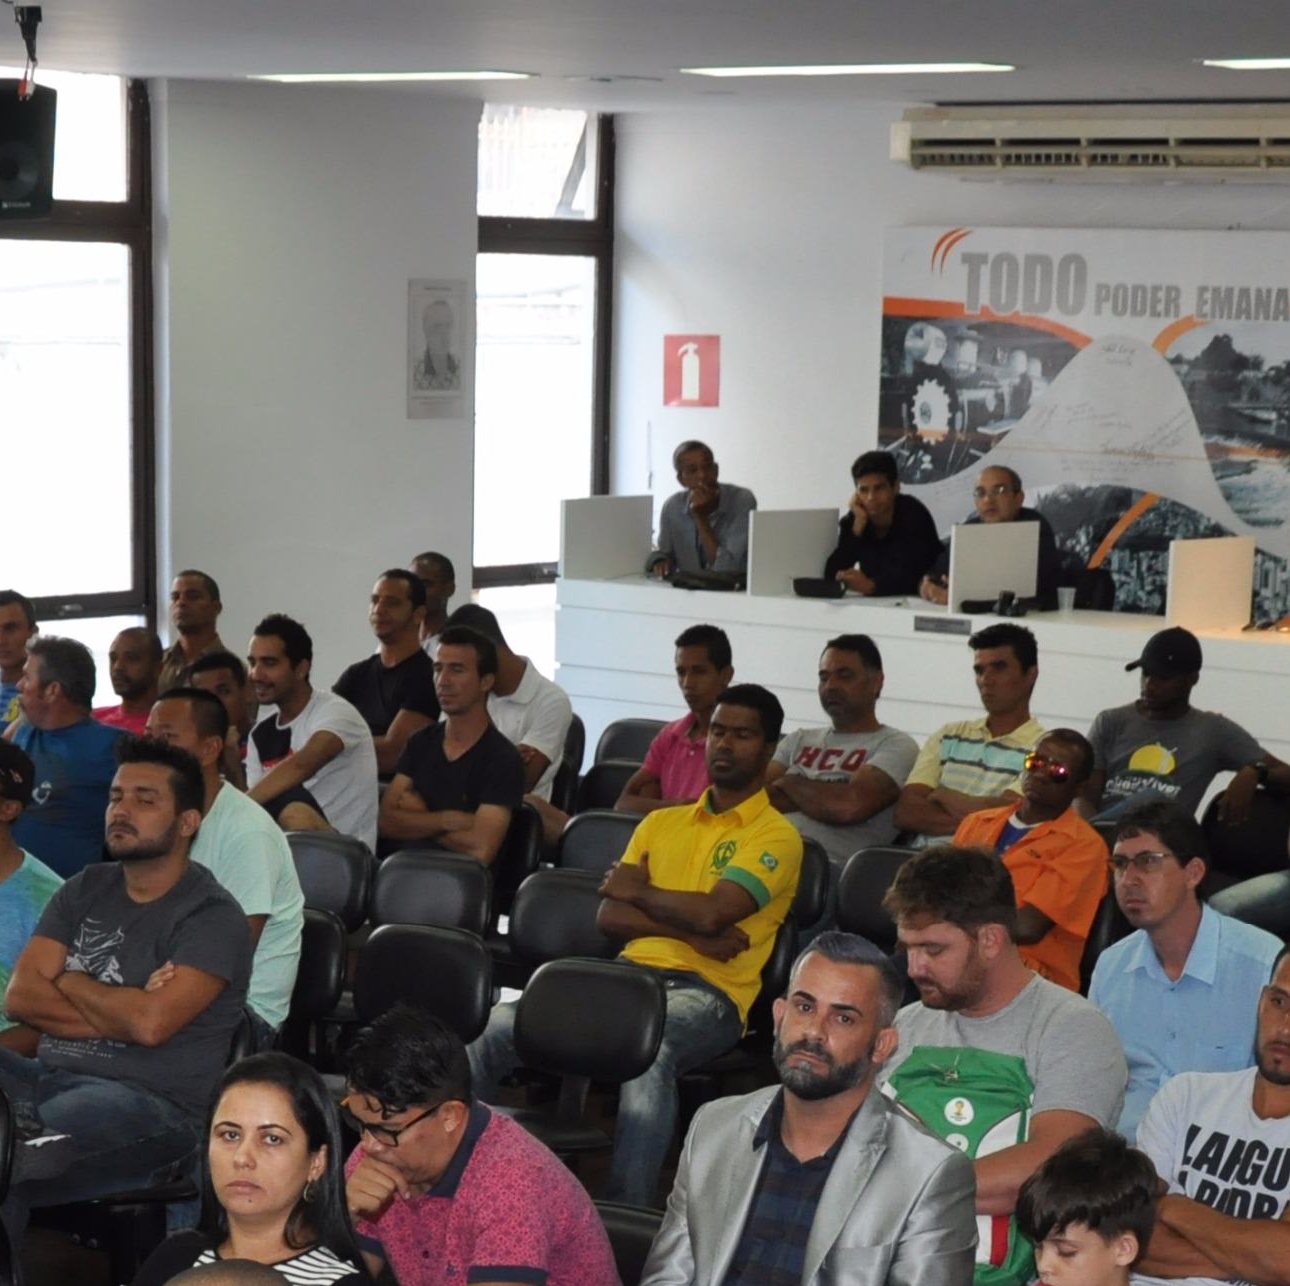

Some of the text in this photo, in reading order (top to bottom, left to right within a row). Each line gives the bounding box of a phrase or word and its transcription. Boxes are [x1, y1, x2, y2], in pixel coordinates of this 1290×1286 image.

[961, 253, 1087, 316] TODO
[1094, 283, 1182, 318] PODER
[1195, 285, 1290, 322] EMANA
